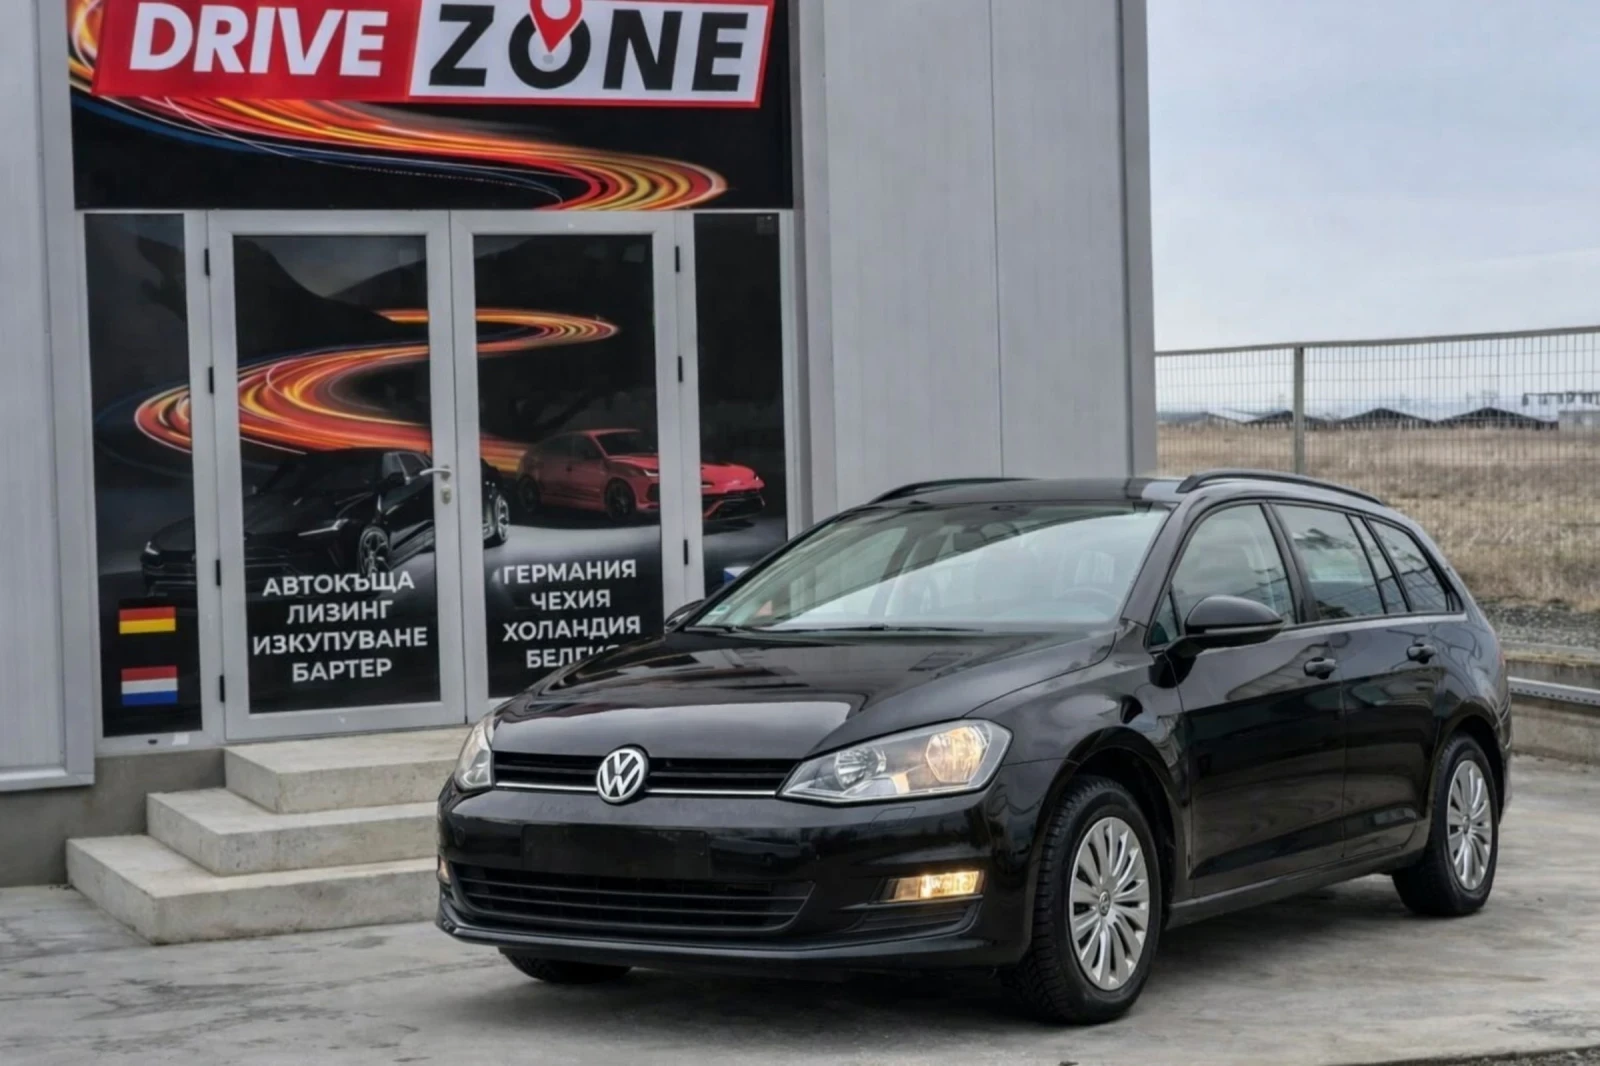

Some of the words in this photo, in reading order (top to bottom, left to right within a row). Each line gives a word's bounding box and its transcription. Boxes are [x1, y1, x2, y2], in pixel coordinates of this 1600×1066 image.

[129, 3, 387, 76] DRIVE
[429, 4, 748, 91] ZONE
[262, 570, 415, 597] АВТОКЪЩА
[503, 559, 637, 585] ГЕРМАНИЯ
[286, 600, 394, 625] ЛИЗИНГ
[530, 589, 611, 611] ЧЕХИЯ
[252, 627, 428, 656] ИЗКУПУВАНЕ
[502, 616, 642, 642] ХОЛАНДИЯ
[526, 644, 620, 669] БЕЛГ
[291, 657, 393, 683] БАРТЕР
